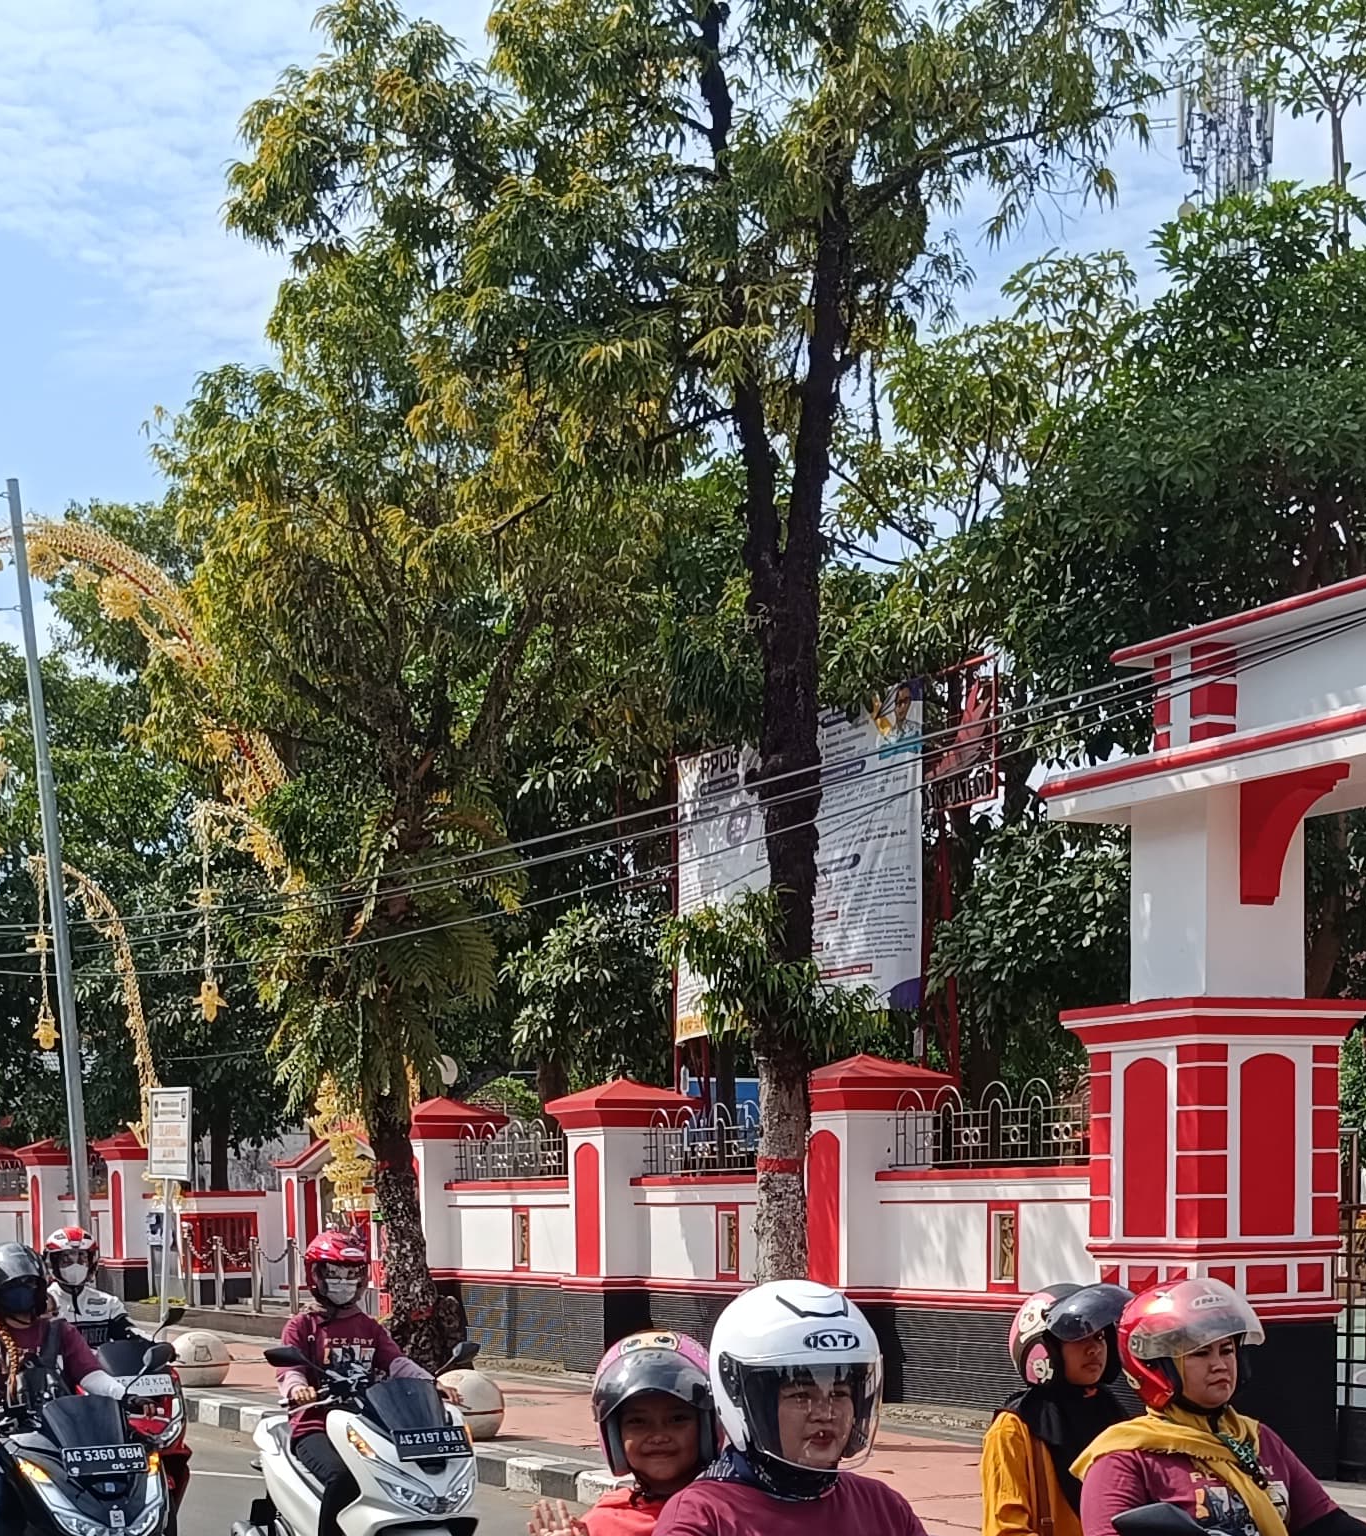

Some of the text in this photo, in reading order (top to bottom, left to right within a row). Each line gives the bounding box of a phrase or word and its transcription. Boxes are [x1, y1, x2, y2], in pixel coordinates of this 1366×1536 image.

[353, 1337, 374, 1346] DAY
[812, 1334, 853, 1349] KYT
[399, 1434, 413, 1445] AG
[413, 1431, 440, 1444] 2197
[66, 1450, 82, 1463] AG
[83, 1448, 116, 1462] 5360
